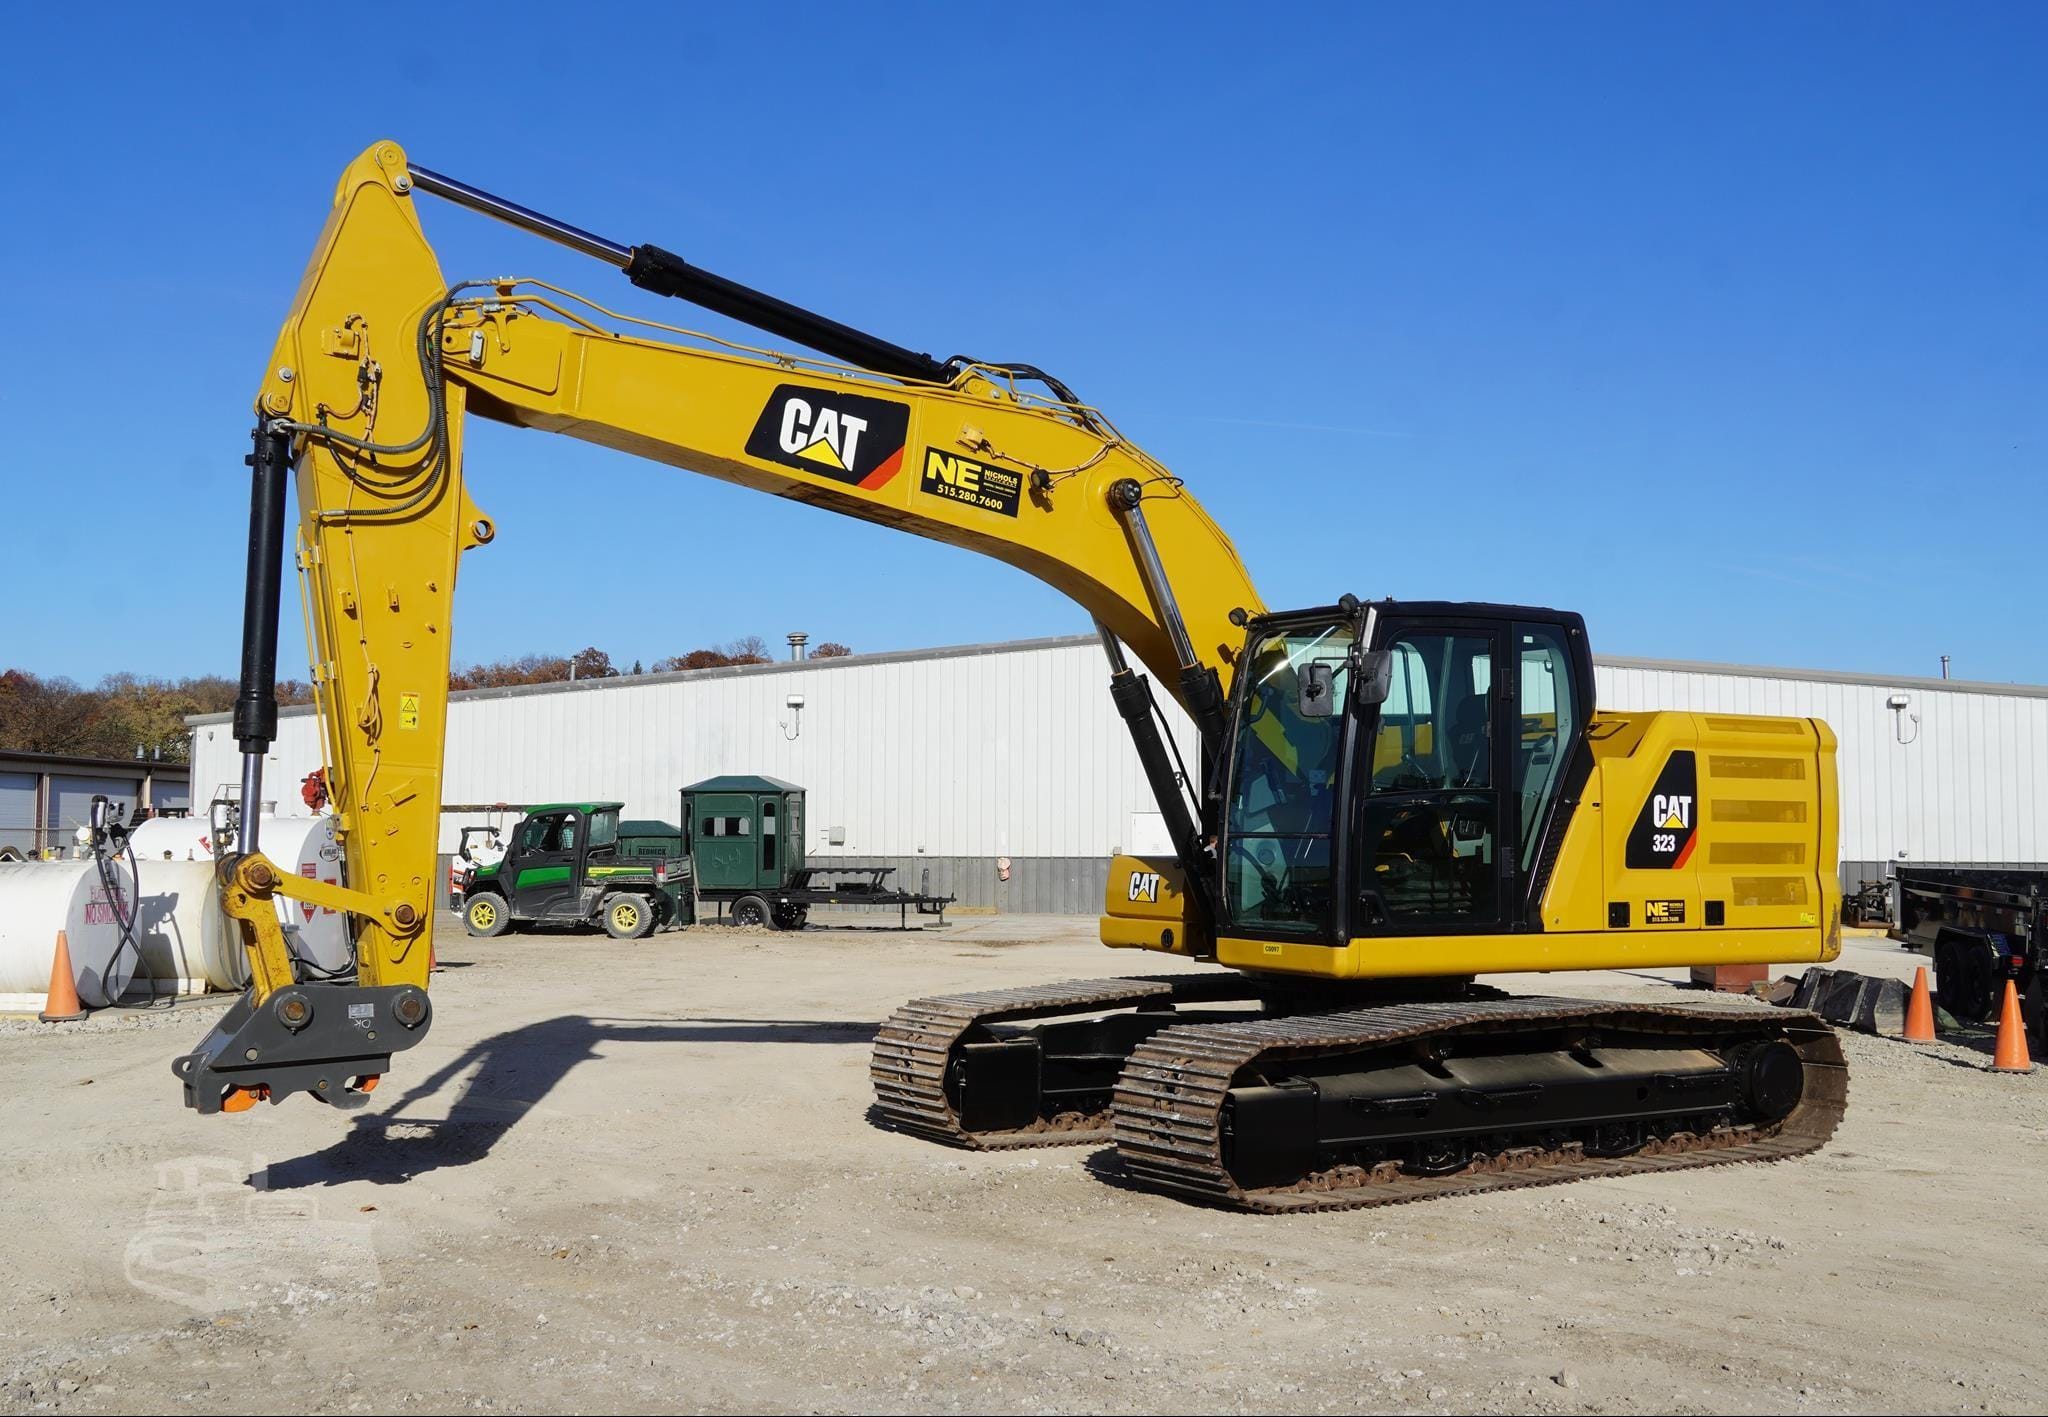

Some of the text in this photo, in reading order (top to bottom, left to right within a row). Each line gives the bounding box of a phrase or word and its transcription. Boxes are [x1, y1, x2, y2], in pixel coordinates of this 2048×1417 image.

[779, 397, 868, 472] CAT
[926, 452, 982, 492] NE
[984, 469, 1018, 486] NICHOLS
[937, 484, 1003, 510] 515.280.7600
[1653, 794, 1692, 829] CAT
[639, 847, 667, 856] REDNECK
[1652, 834, 1676, 852] 323
[1129, 872, 1160, 902] CAT
[84, 903, 97, 925] NO
[1646, 901, 1669, 917] NE
